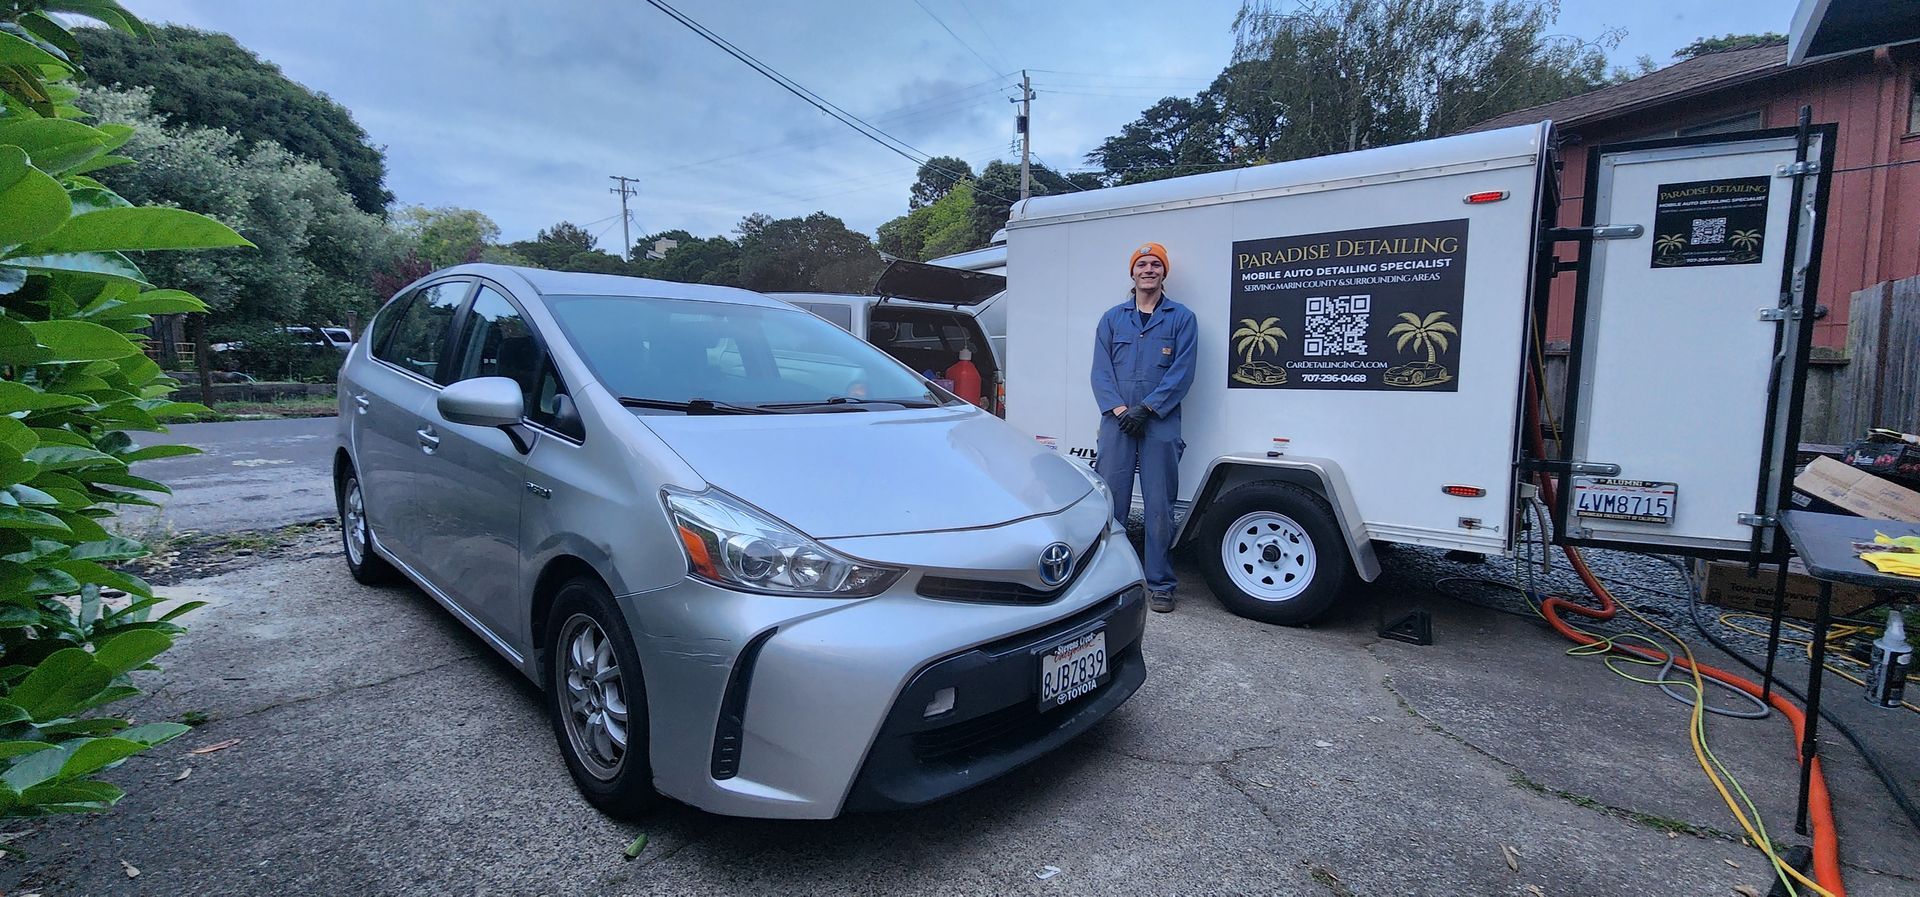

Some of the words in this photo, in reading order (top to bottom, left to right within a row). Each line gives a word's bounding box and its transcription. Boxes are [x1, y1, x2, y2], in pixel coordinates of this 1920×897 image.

[1238, 243, 1330, 270] PARADISE
[1336, 237, 1458, 257] DETAILING
[1242, 271, 1281, 281] MOBILE
[1284, 268, 1313, 279] AUTO
[1316, 263, 1377, 277] DETAILING
[1380, 258, 1452, 272] SPECIALIST
[1244, 283, 1275, 292] SERVING
[1276, 281, 1302, 290] MARIN
[1302, 279, 1338, 289] COUNTY
[1411, 272, 1441, 282] AREAS
[1302, 373, 1367, 383] 707-296-0468
[1606, 479, 1643, 487] ALUMNI
[1579, 493, 1668, 516] 4VM8715
[1044, 649, 1104, 699] 8JBZ839
[1067, 679, 1097, 701] TOYOTA
